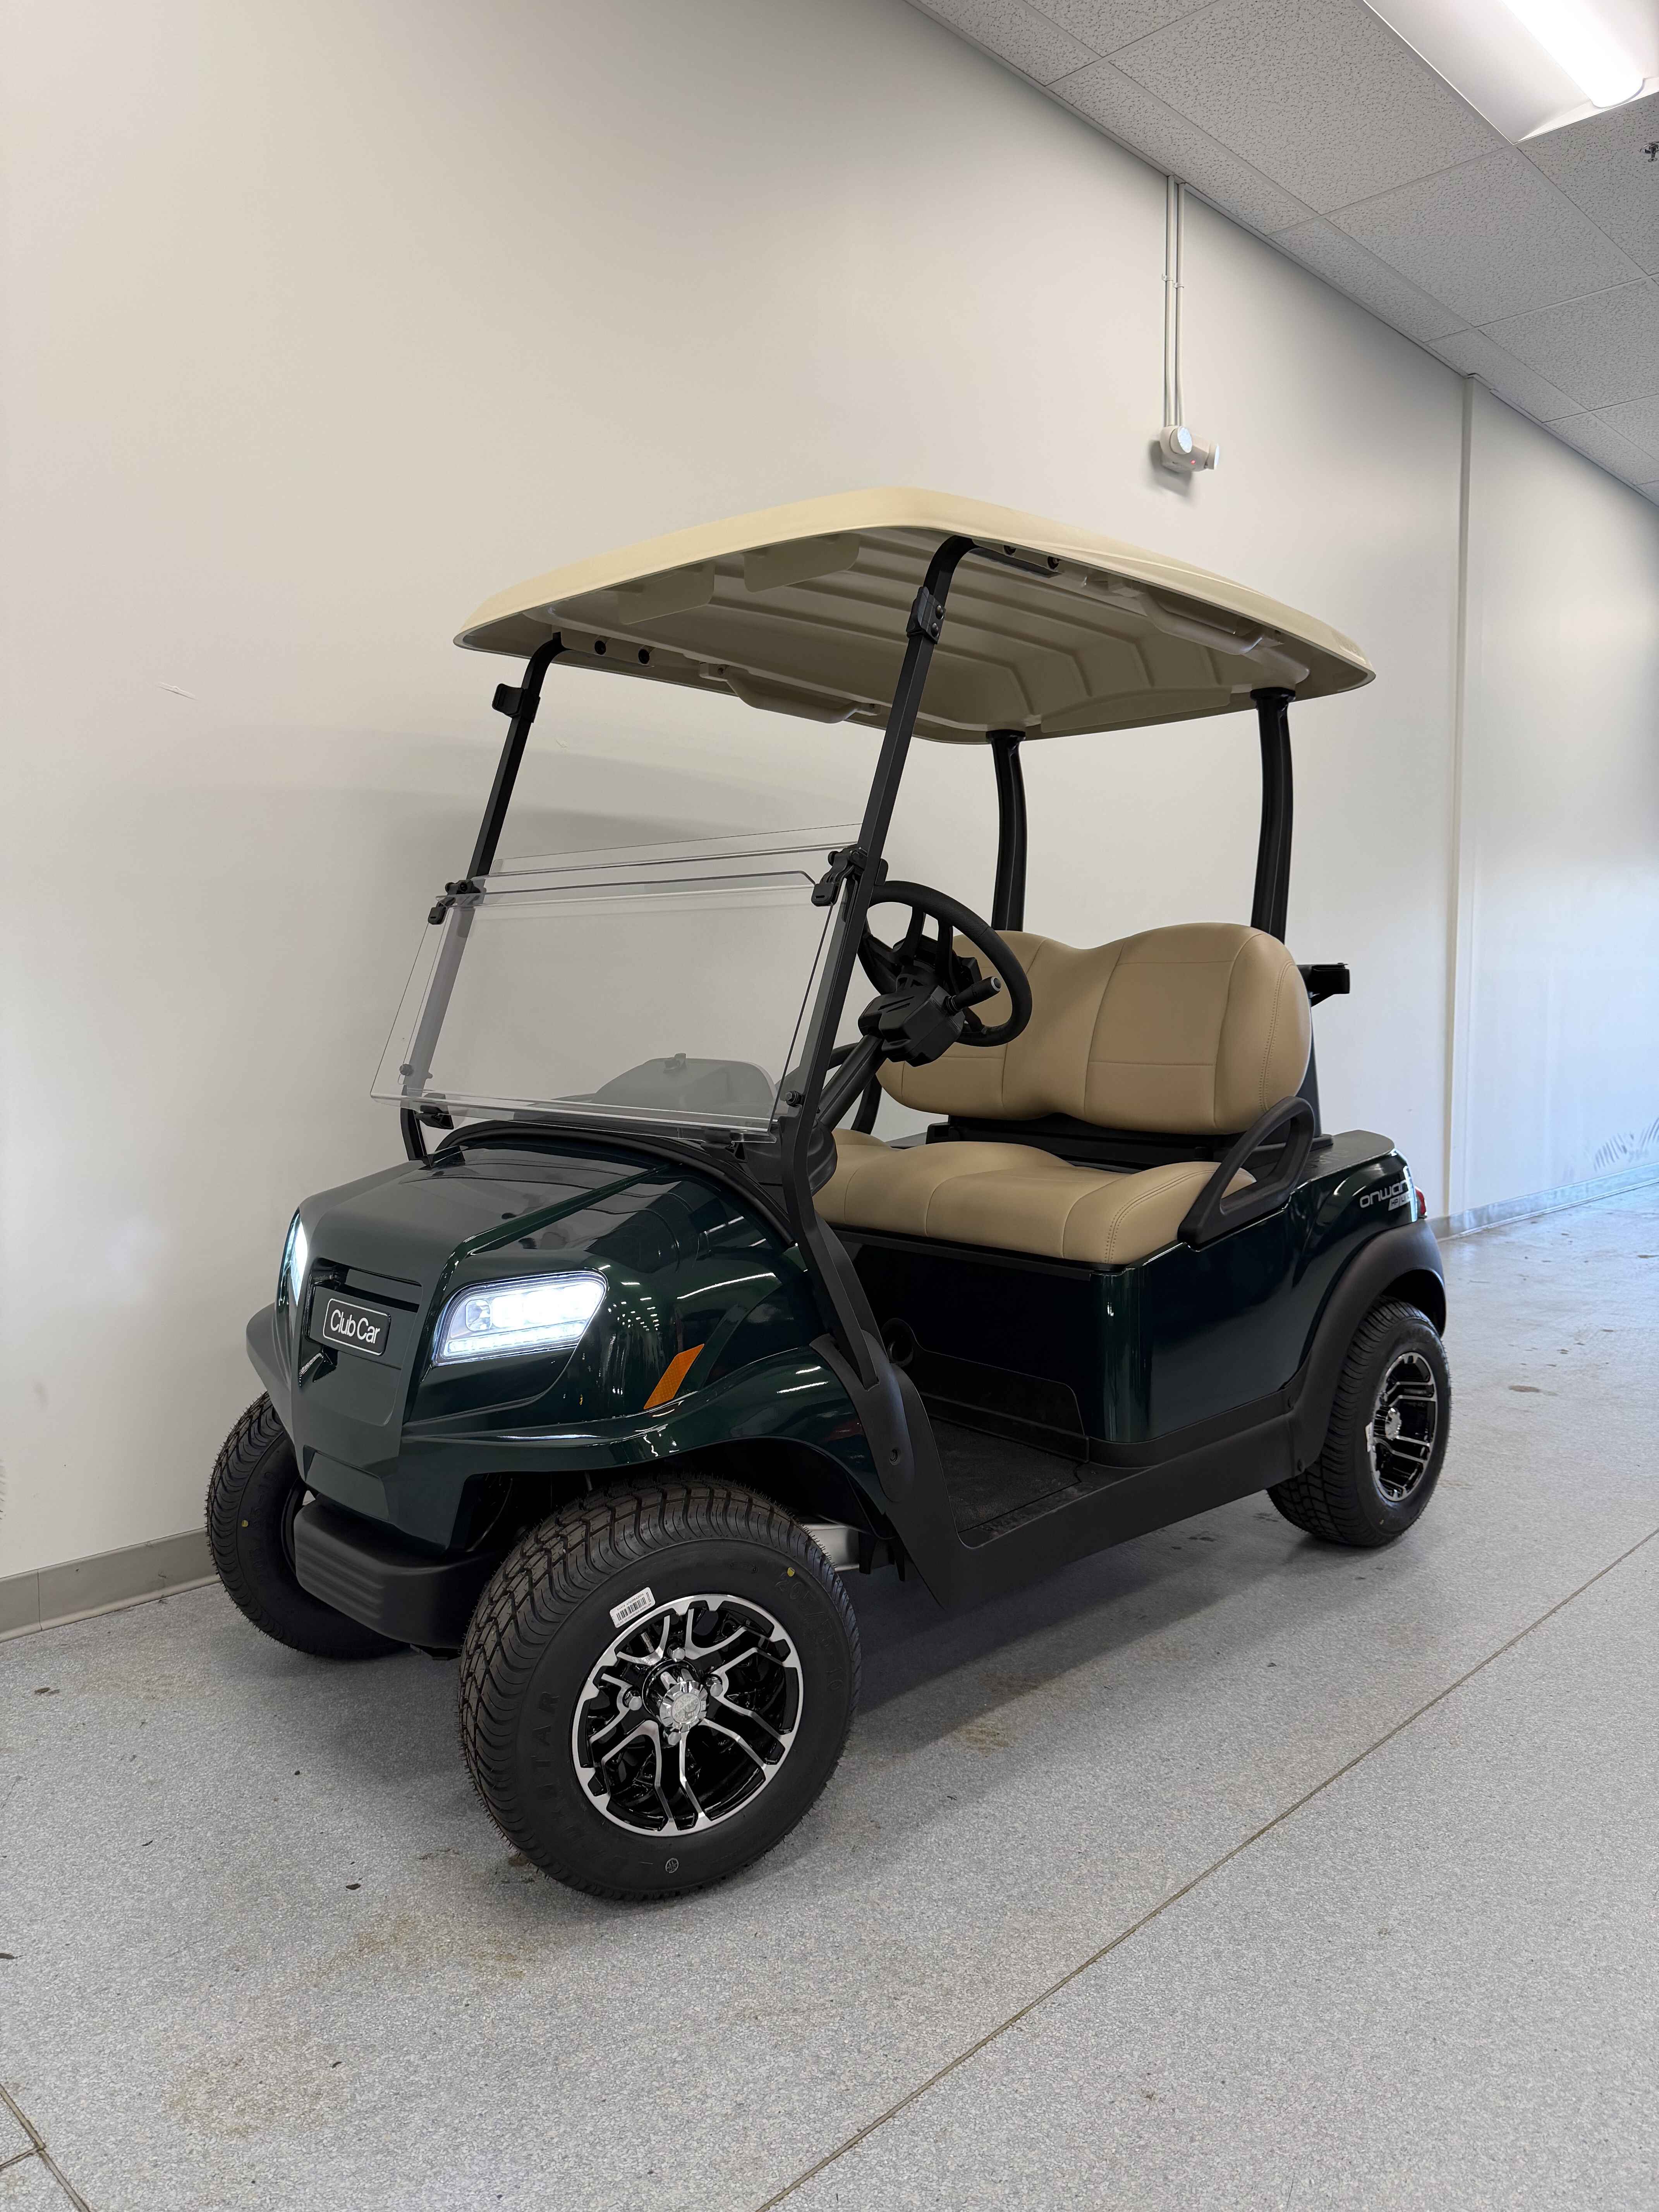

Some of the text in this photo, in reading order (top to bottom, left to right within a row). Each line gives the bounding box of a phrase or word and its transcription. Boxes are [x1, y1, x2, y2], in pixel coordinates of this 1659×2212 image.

[1360, 1179, 1408, 1208] onwar
[330, 1309, 380, 1344] Club Car
